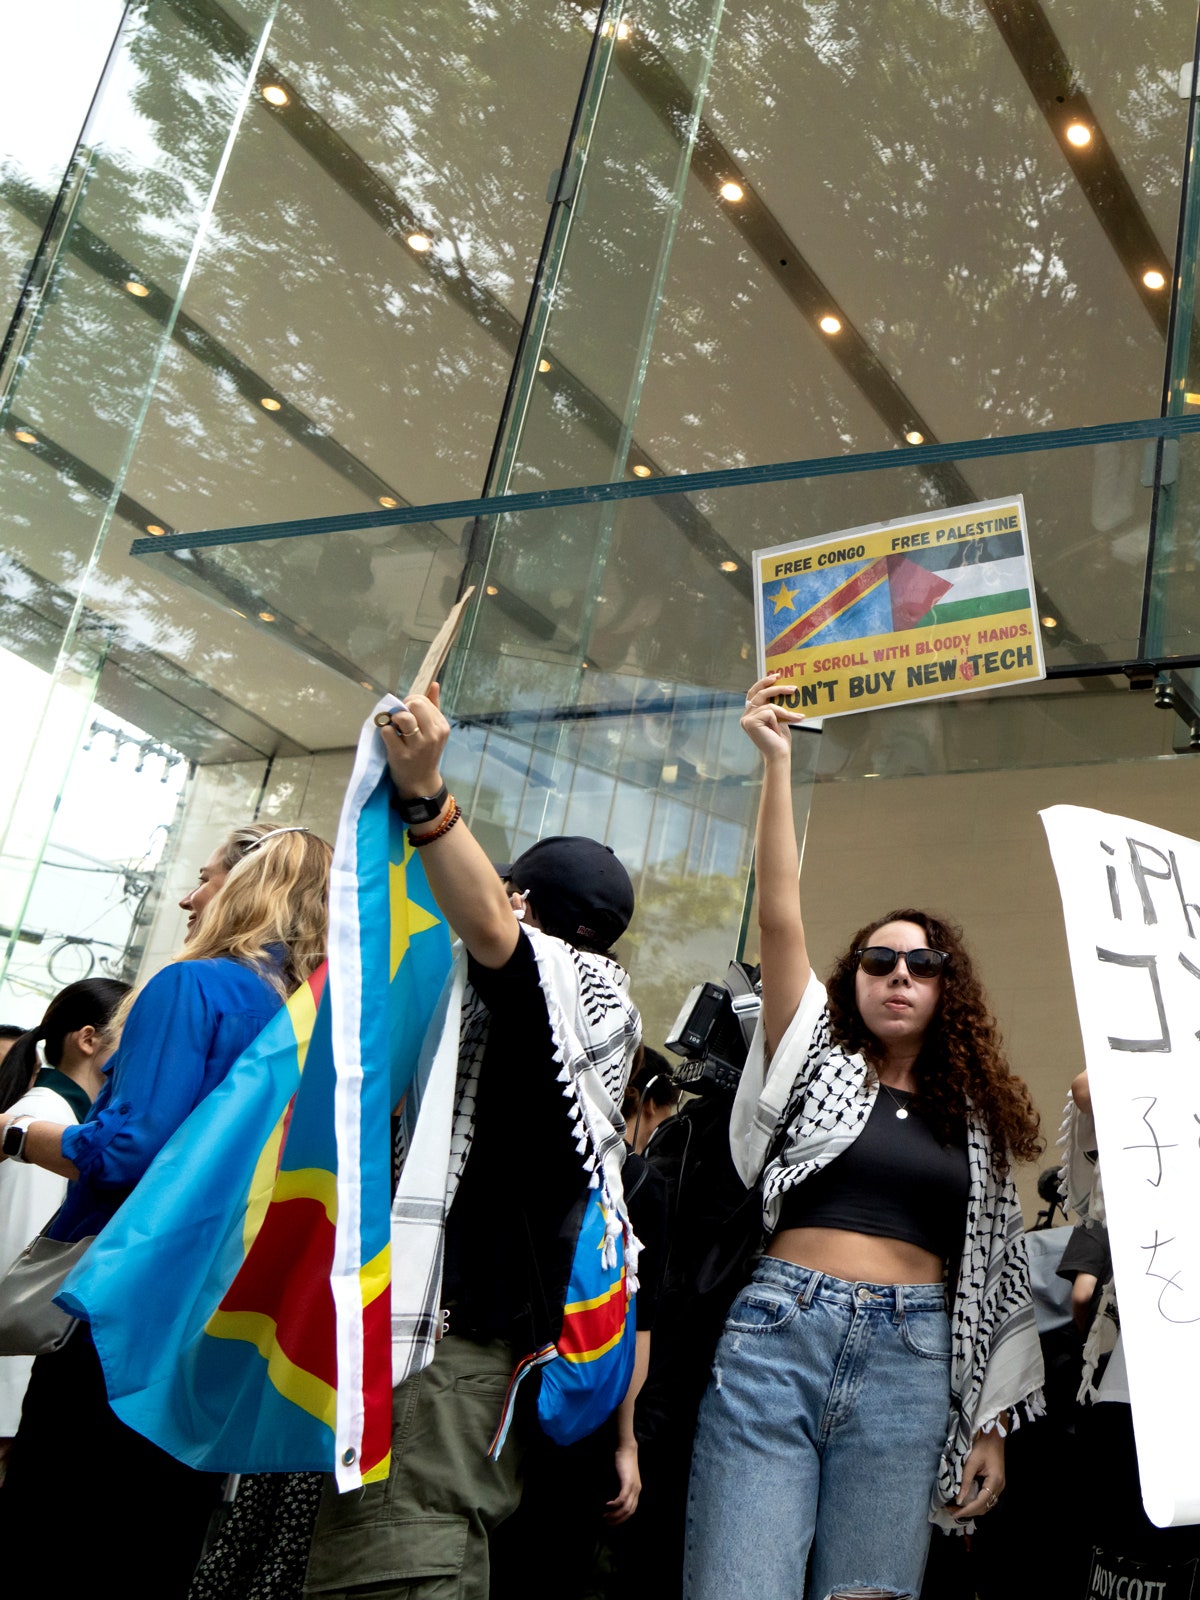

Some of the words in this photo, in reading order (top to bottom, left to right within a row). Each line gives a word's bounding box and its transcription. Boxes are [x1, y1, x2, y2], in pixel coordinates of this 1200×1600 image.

[775, 557, 812, 577] FREE
[817, 545, 866, 567] CONGO
[891, 531, 931, 551] FREE
[936, 515, 1018, 542] PALESTINE
[813, 652, 869, 675] SCROLL
[873, 644, 910, 663] WITH
[915, 634, 971, 655] BLOODY
[977, 623, 1032, 645] HANDS.
[849, 669, 896, 699] BUY
[907, 659, 957, 688] NEW
[967, 645, 1033, 676] TECH
[1092, 1564, 1166, 1600] BOYCOTT
